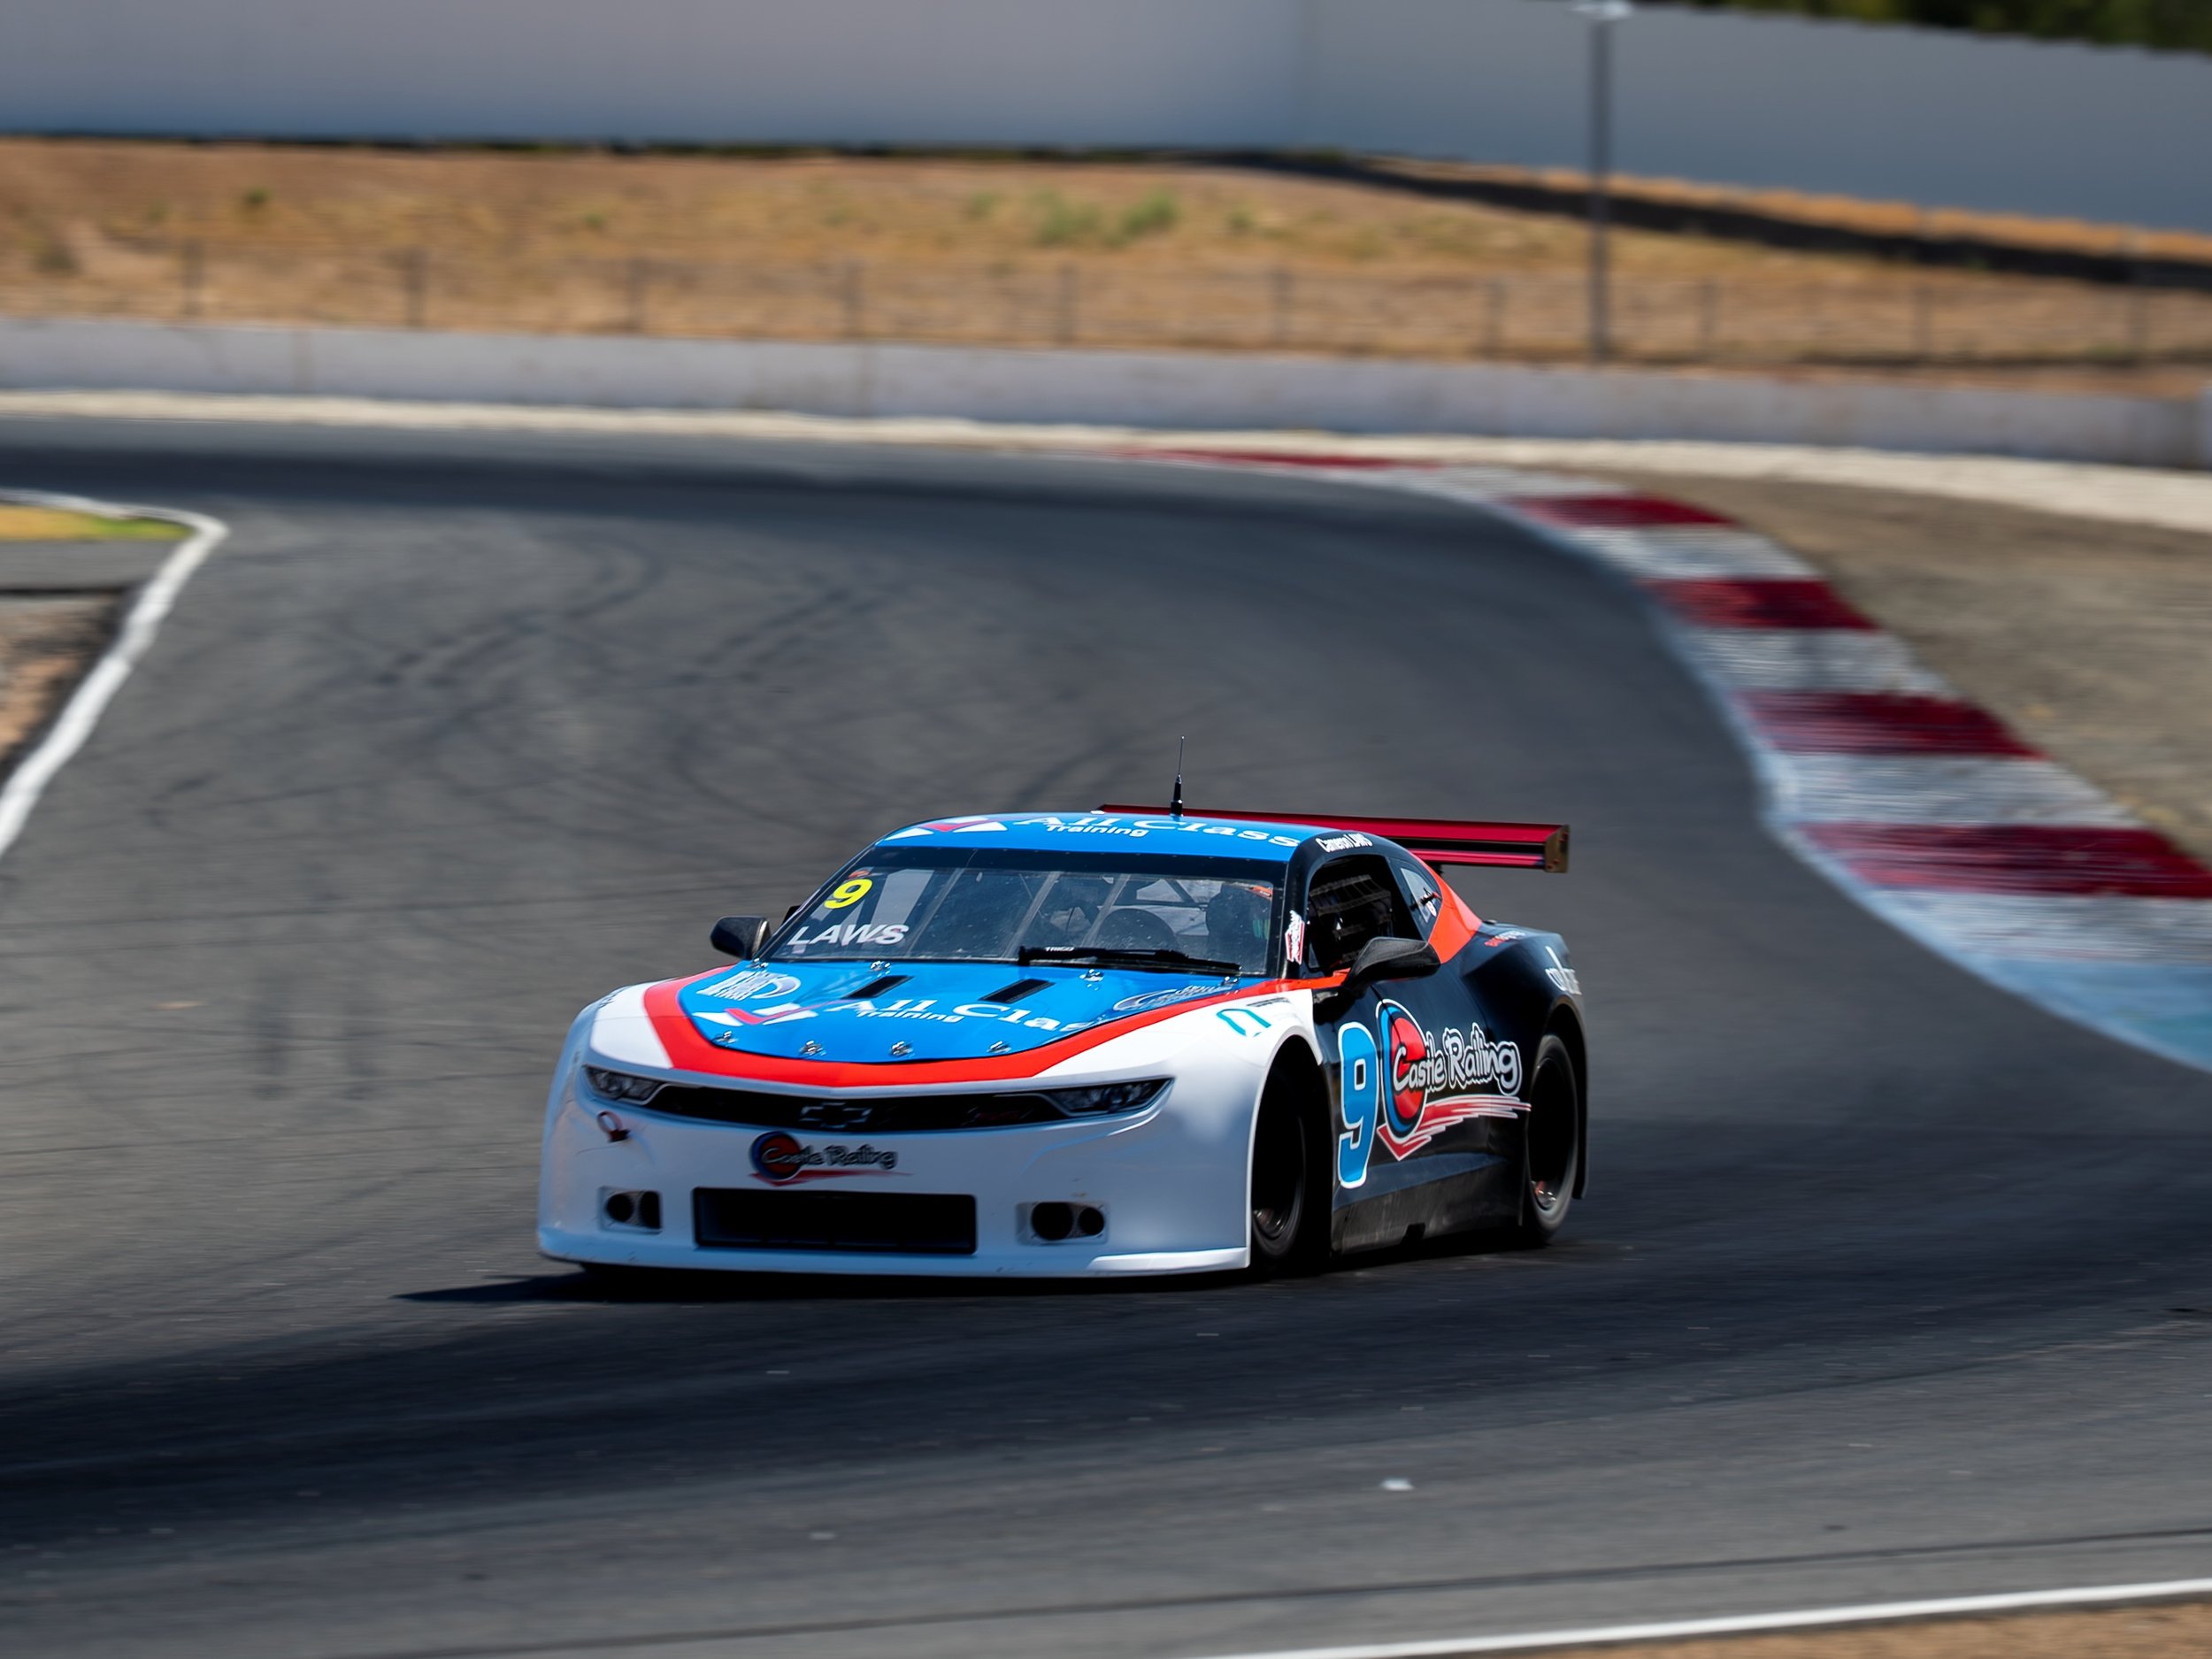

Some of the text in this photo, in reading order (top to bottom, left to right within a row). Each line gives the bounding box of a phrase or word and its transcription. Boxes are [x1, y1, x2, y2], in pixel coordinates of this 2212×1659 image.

[1012, 817, 1301, 847] All Class
[1046, 823, 1149, 838] Training
[824, 879, 873, 909] 9
[787, 924, 910, 946] LAWS
[823, 999, 938, 1013] All
[856, 1010, 965, 1024] Training
[1393, 1026, 1519, 1094] Castle Railing
[1338, 1022, 1379, 1189] 9
